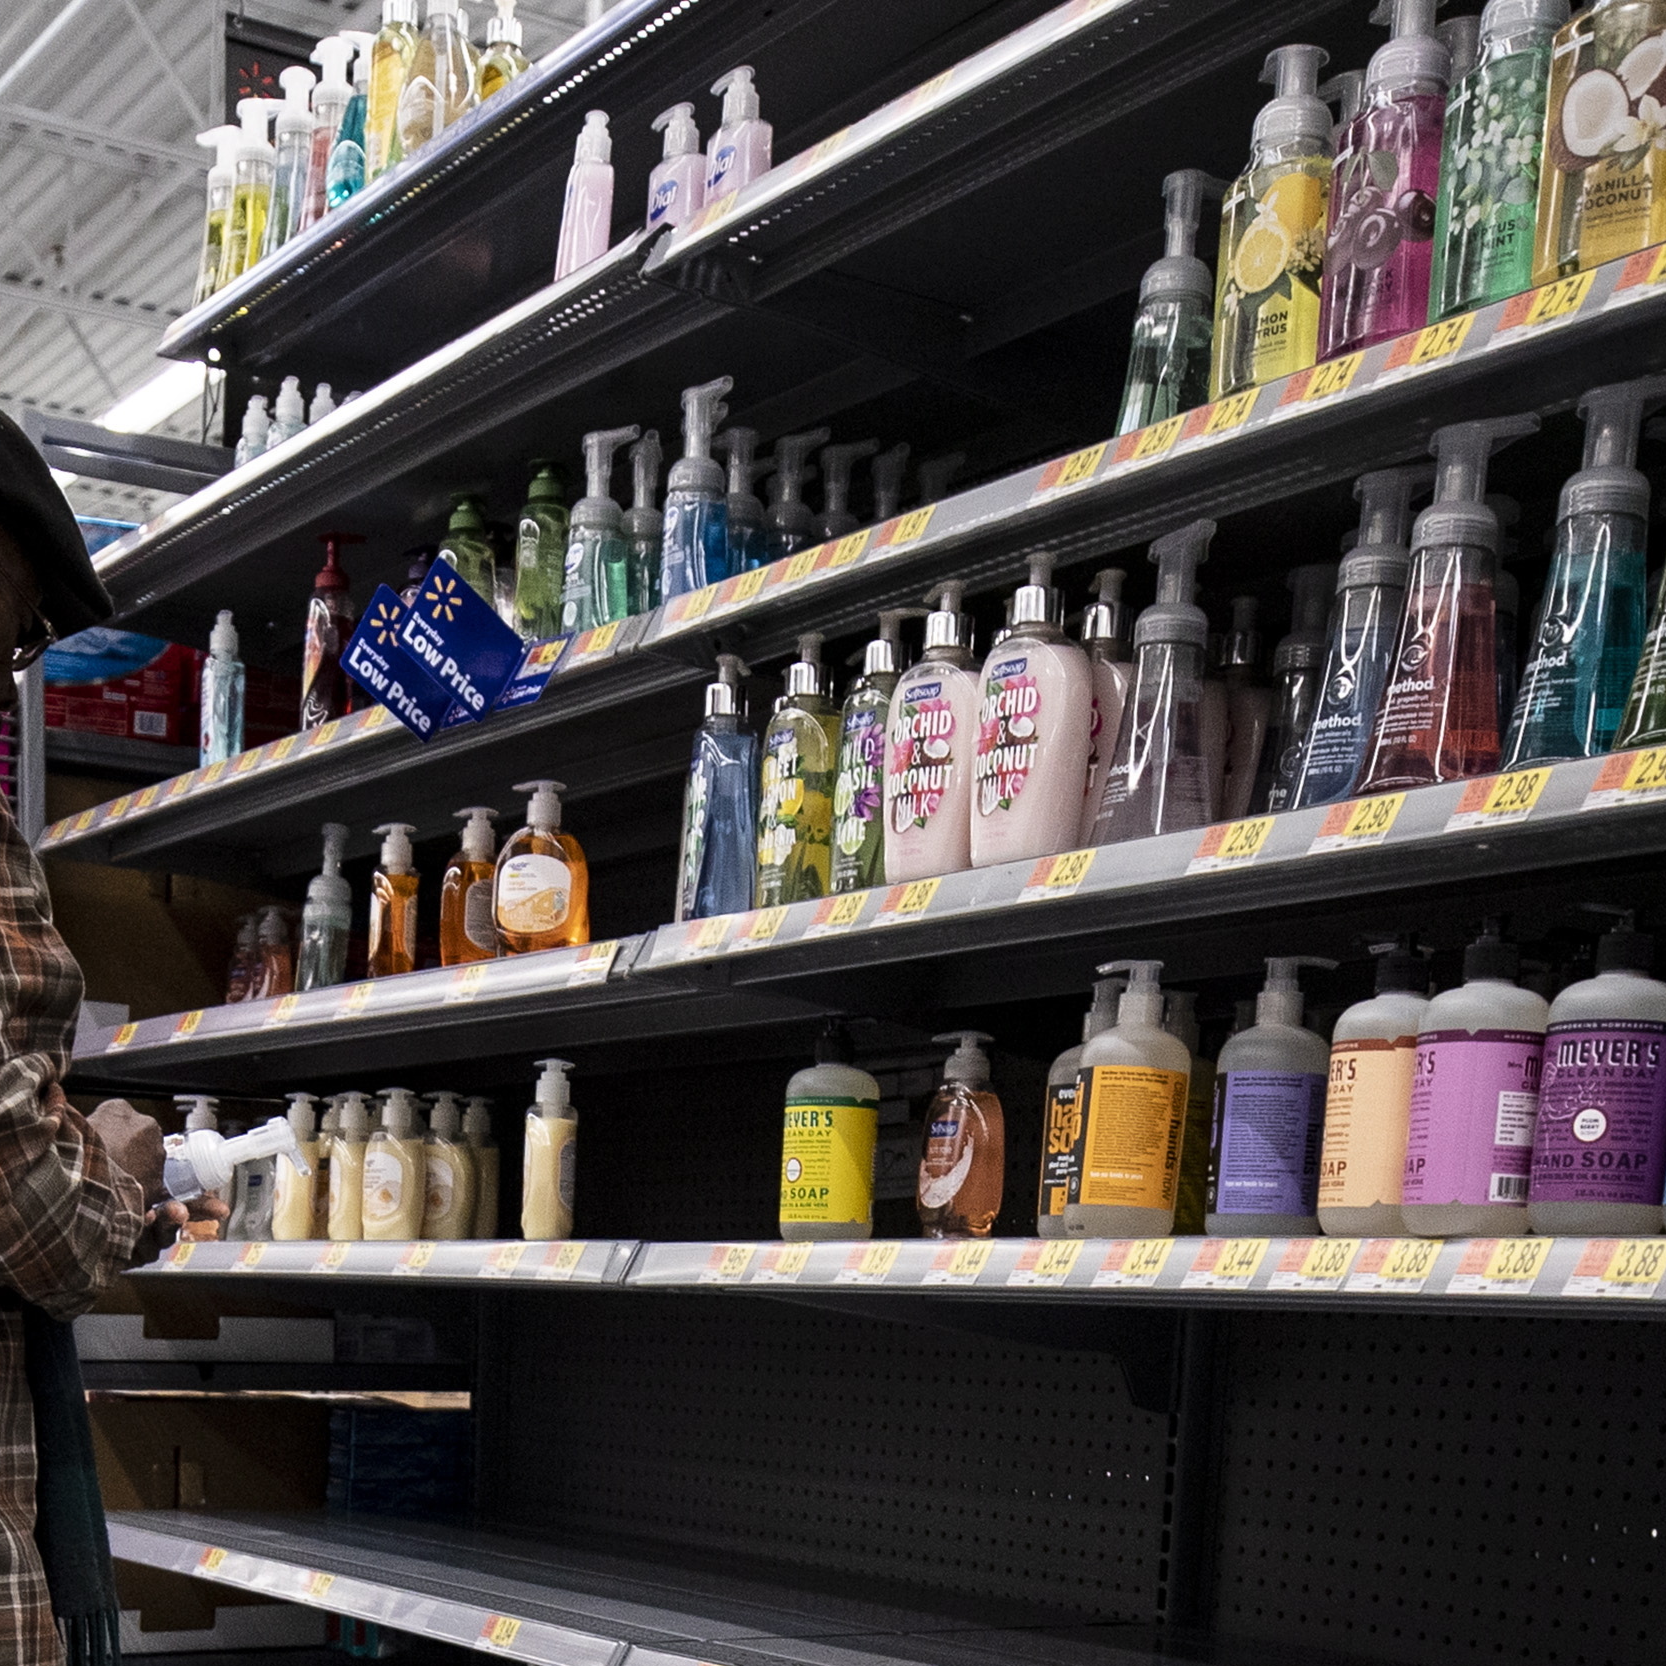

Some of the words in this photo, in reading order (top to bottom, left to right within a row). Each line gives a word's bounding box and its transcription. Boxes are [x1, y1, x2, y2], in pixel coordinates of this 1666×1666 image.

[1583, 187, 1651, 212] OCONUT
[412, 611, 445, 646] Everyday
[358, 637, 391, 671] Everyday
[401, 620, 443, 668] Low
[439, 656, 485, 712] Price
[347, 645, 390, 692] Low
[385, 680, 432, 733] Price
[982, 686, 1038, 723] ORCHID
[893, 710, 952, 741] ORCHID
[996, 720, 1008, 746] &
[842, 737, 874, 768] WILD
[910, 742, 921, 766] &
[974, 743, 1039, 782] COCONUT
[887, 764, 954, 802] COCONUT
[981, 775, 1016, 801] MILK
[895, 795, 931, 820] MILK
[1556, 1039, 1662, 1069] MEYER'S
[1556, 1067, 1618, 1079] CLEAN
[1622, 1068, 1659, 1079] DAY
[813, 1128, 832, 1138] DAY
[1164, 1119, 1181, 1174] hands
[1535, 1153, 1575, 1168] HAND
[1580, 1151, 1649, 1170] SOAP
[789, 1186, 831, 1200] SOAP
